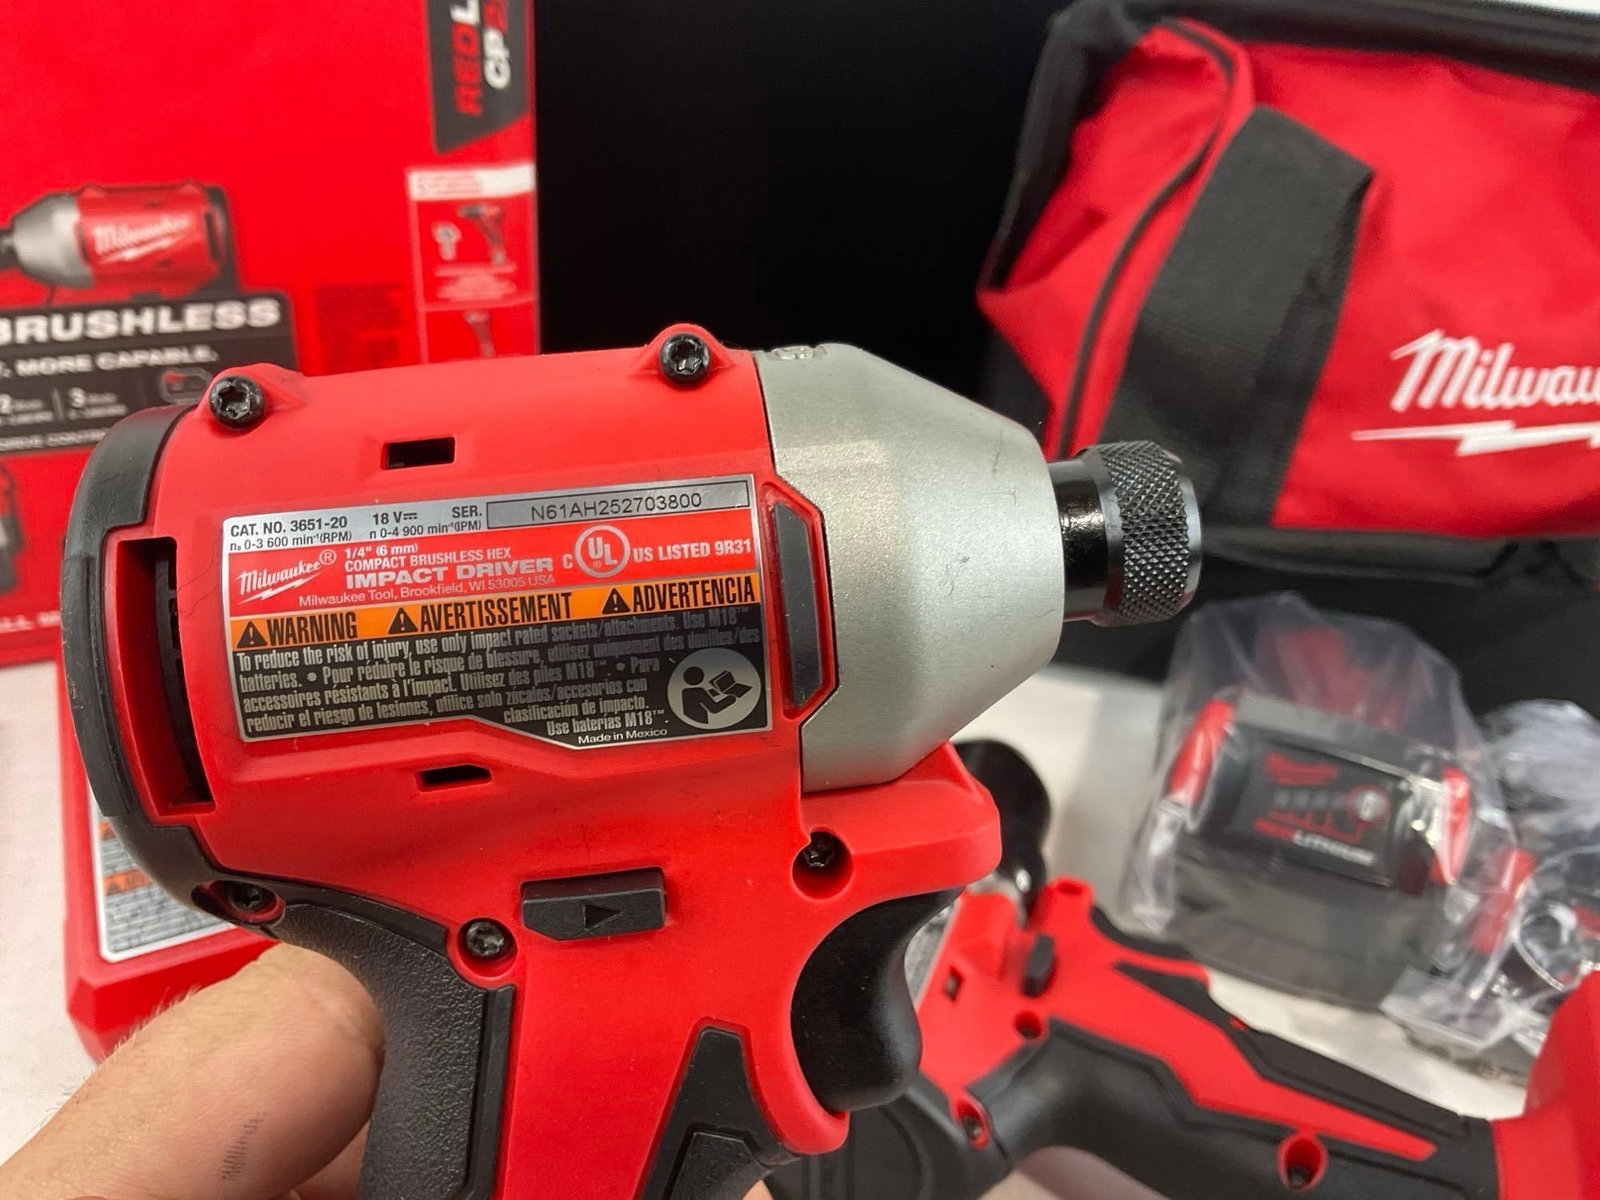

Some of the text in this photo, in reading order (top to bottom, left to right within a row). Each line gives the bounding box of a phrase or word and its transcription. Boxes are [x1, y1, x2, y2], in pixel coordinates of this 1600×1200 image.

[14, 354, 93, 377] MORE
[372, 512, 389, 526] 18
[451, 493, 702, 521] SER. N61AH252703800
[230, 516, 347, 537] CAT. NO. 3651-20
[369, 531, 377, 540] n
[380, 527, 399, 539] 0-4
[402, 525, 424, 536] 900
[244, 536, 263, 550] 0-3
[267, 536, 288, 548] 600
[345, 543, 418, 559] 1/4" (6 mm)
[633, 547, 653, 562] US
[658, 542, 710, 560] LISTED
[714, 538, 751, 555] 9R31
[345, 547, 511, 572] COMPACT BRUSHLESS HEX
[346, 557, 553, 589] IMPACT DRIVER
[299, 574, 555, 607] Milwaukee Tool, Brookfield, WI 53005 USA
[633, 576, 755, 612] ADVERTENCIA
[420, 592, 572, 632] AVERTISSEMENT
[237, 652, 251, 672] To
[255, 649, 299, 670] reduce
[303, 647, 323, 666] the
[326, 643, 353, 664] risk
[357, 641, 369, 660] of
[416, 638, 438, 654] use
[442, 633, 467, 654] only
[470, 629, 511, 651] impact
[515, 625, 548, 644] rated
[683, 611, 705, 629] Use
[267, 612, 357, 646] WARNING
[239, 671, 302, 693] batteries.
[323, 666, 353, 685] Pour
[358, 659, 406, 682] réduire
[409, 652, 421, 676] le
[424, 656, 465, 675] risque
[468, 652, 483, 670] de
[486, 649, 544, 669] blessure,
[548, 644, 589, 662] utilisez
[593, 636, 659, 659] uniquement
[663, 634, 684, 651] des
[243, 690, 321, 713] accessoires
[324, 683, 389, 705] résistants
[392, 679, 401, 698] à
[460, 672, 505, 691] Utilisez
[508, 668, 530, 686] des
[534, 663, 562, 686] piles
[630, 657, 659, 674] Para
[246, 712, 295, 732] reducir
[299, 709, 311, 727] el
[314, 708, 355, 725] riesgo
[358, 704, 374, 720] de
[376, 700, 433, 719] lesiones,
[436, 694, 474, 713] utilice
[477, 690, 503, 708] solo
[626, 677, 648, 693] con
[503, 695, 649, 723] clasificación de impacto.
[547, 720, 569, 736] Use
[572, 714, 621, 733] baterías
[578, 728, 668, 745] Made in Mexico
